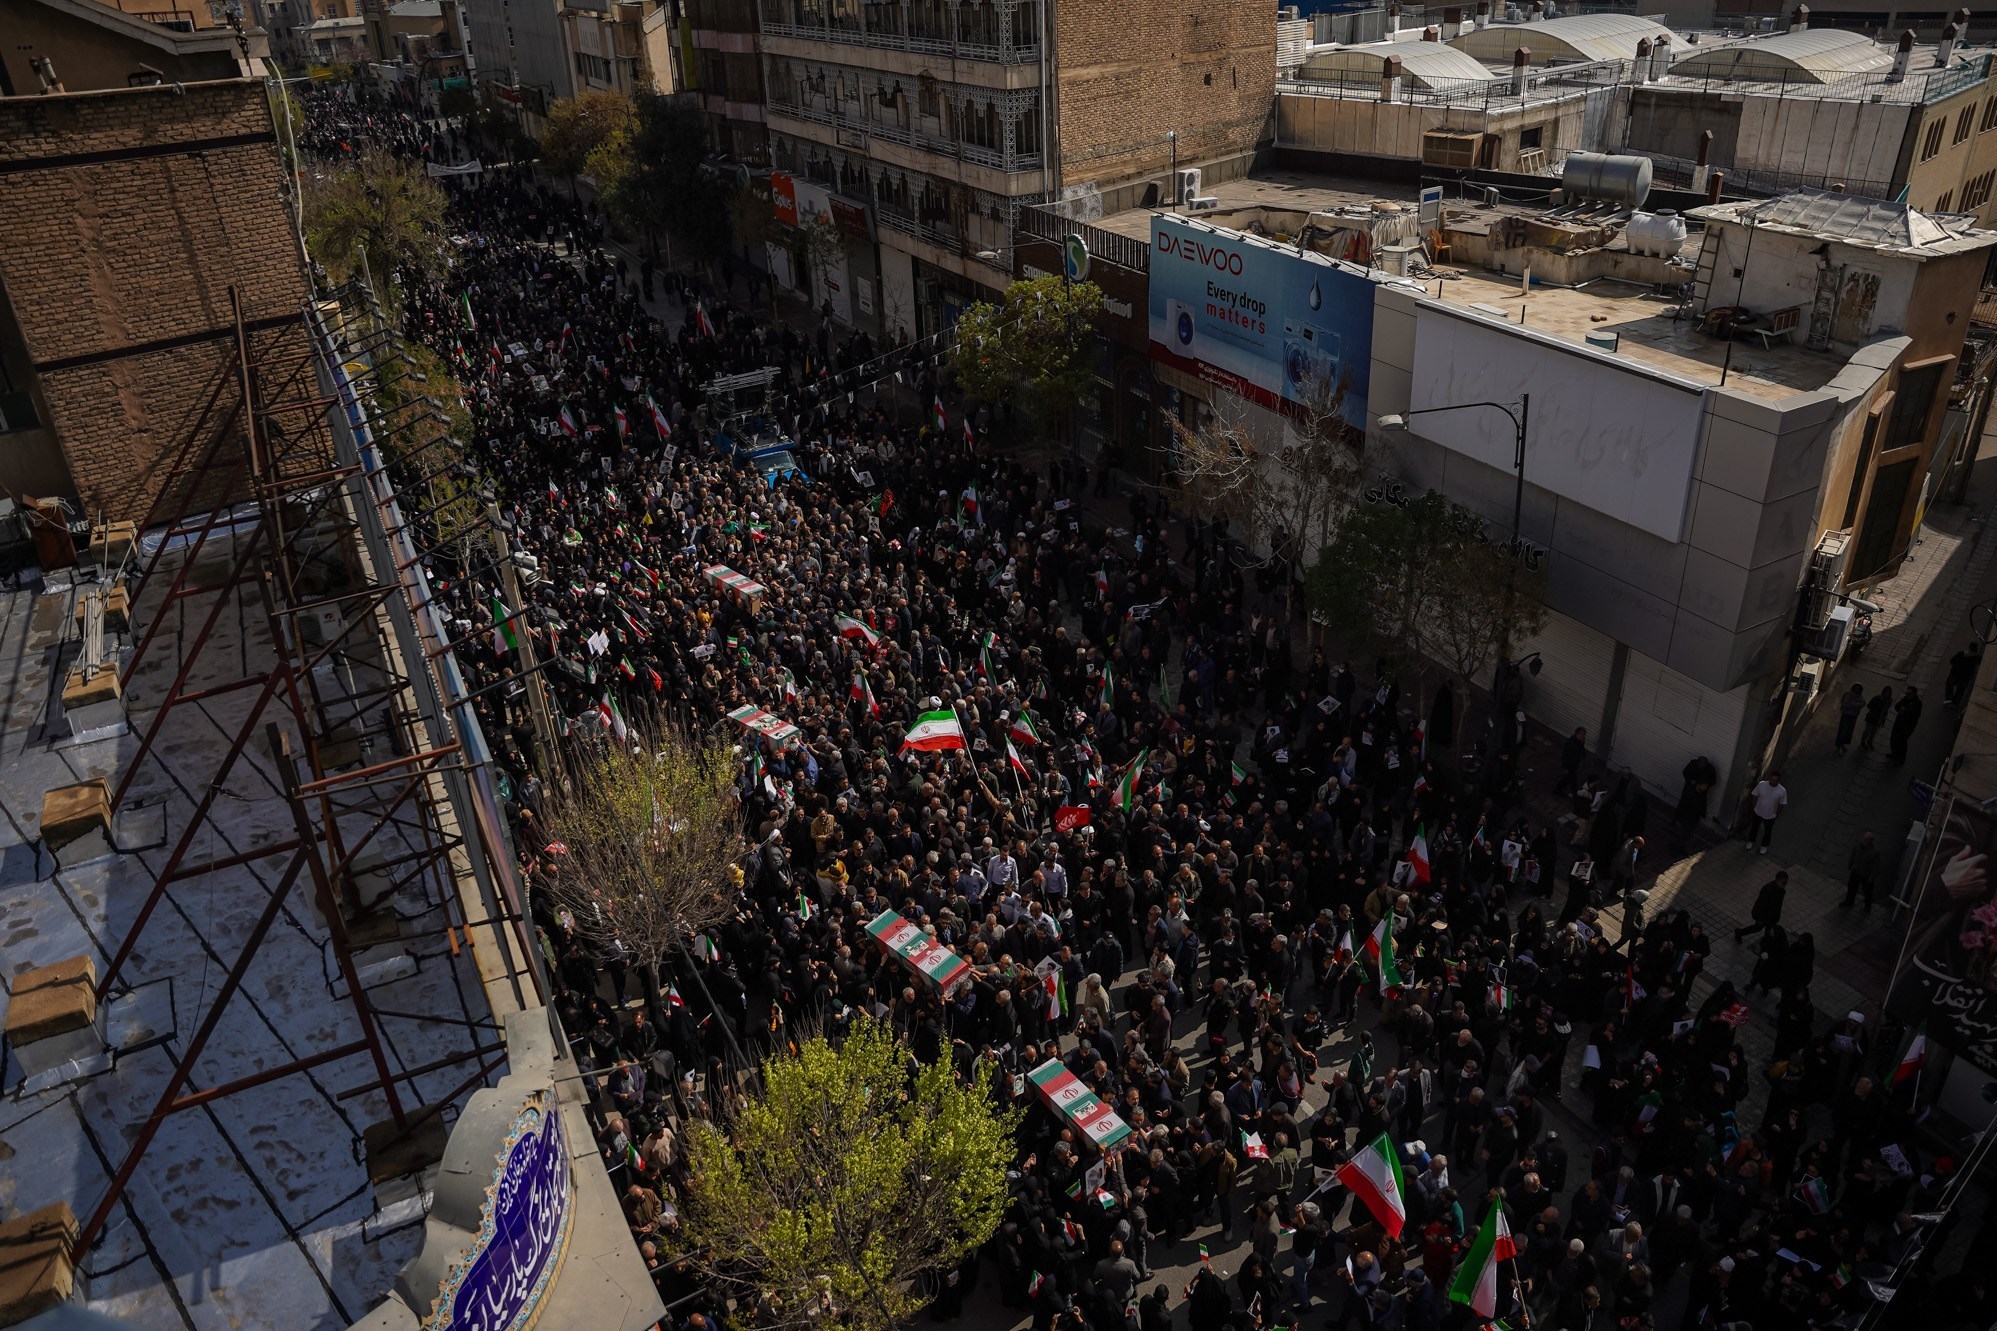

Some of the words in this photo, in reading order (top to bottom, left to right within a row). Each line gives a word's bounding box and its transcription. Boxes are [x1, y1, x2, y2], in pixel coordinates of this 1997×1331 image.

[1158, 231, 1243, 276] DAEWOO
[1206, 302, 1266, 335] matters
[1207, 280, 1238, 309] Every
[1239, 291, 1266, 318] drop
[1912, 952, 1988, 1014] انقلاب
